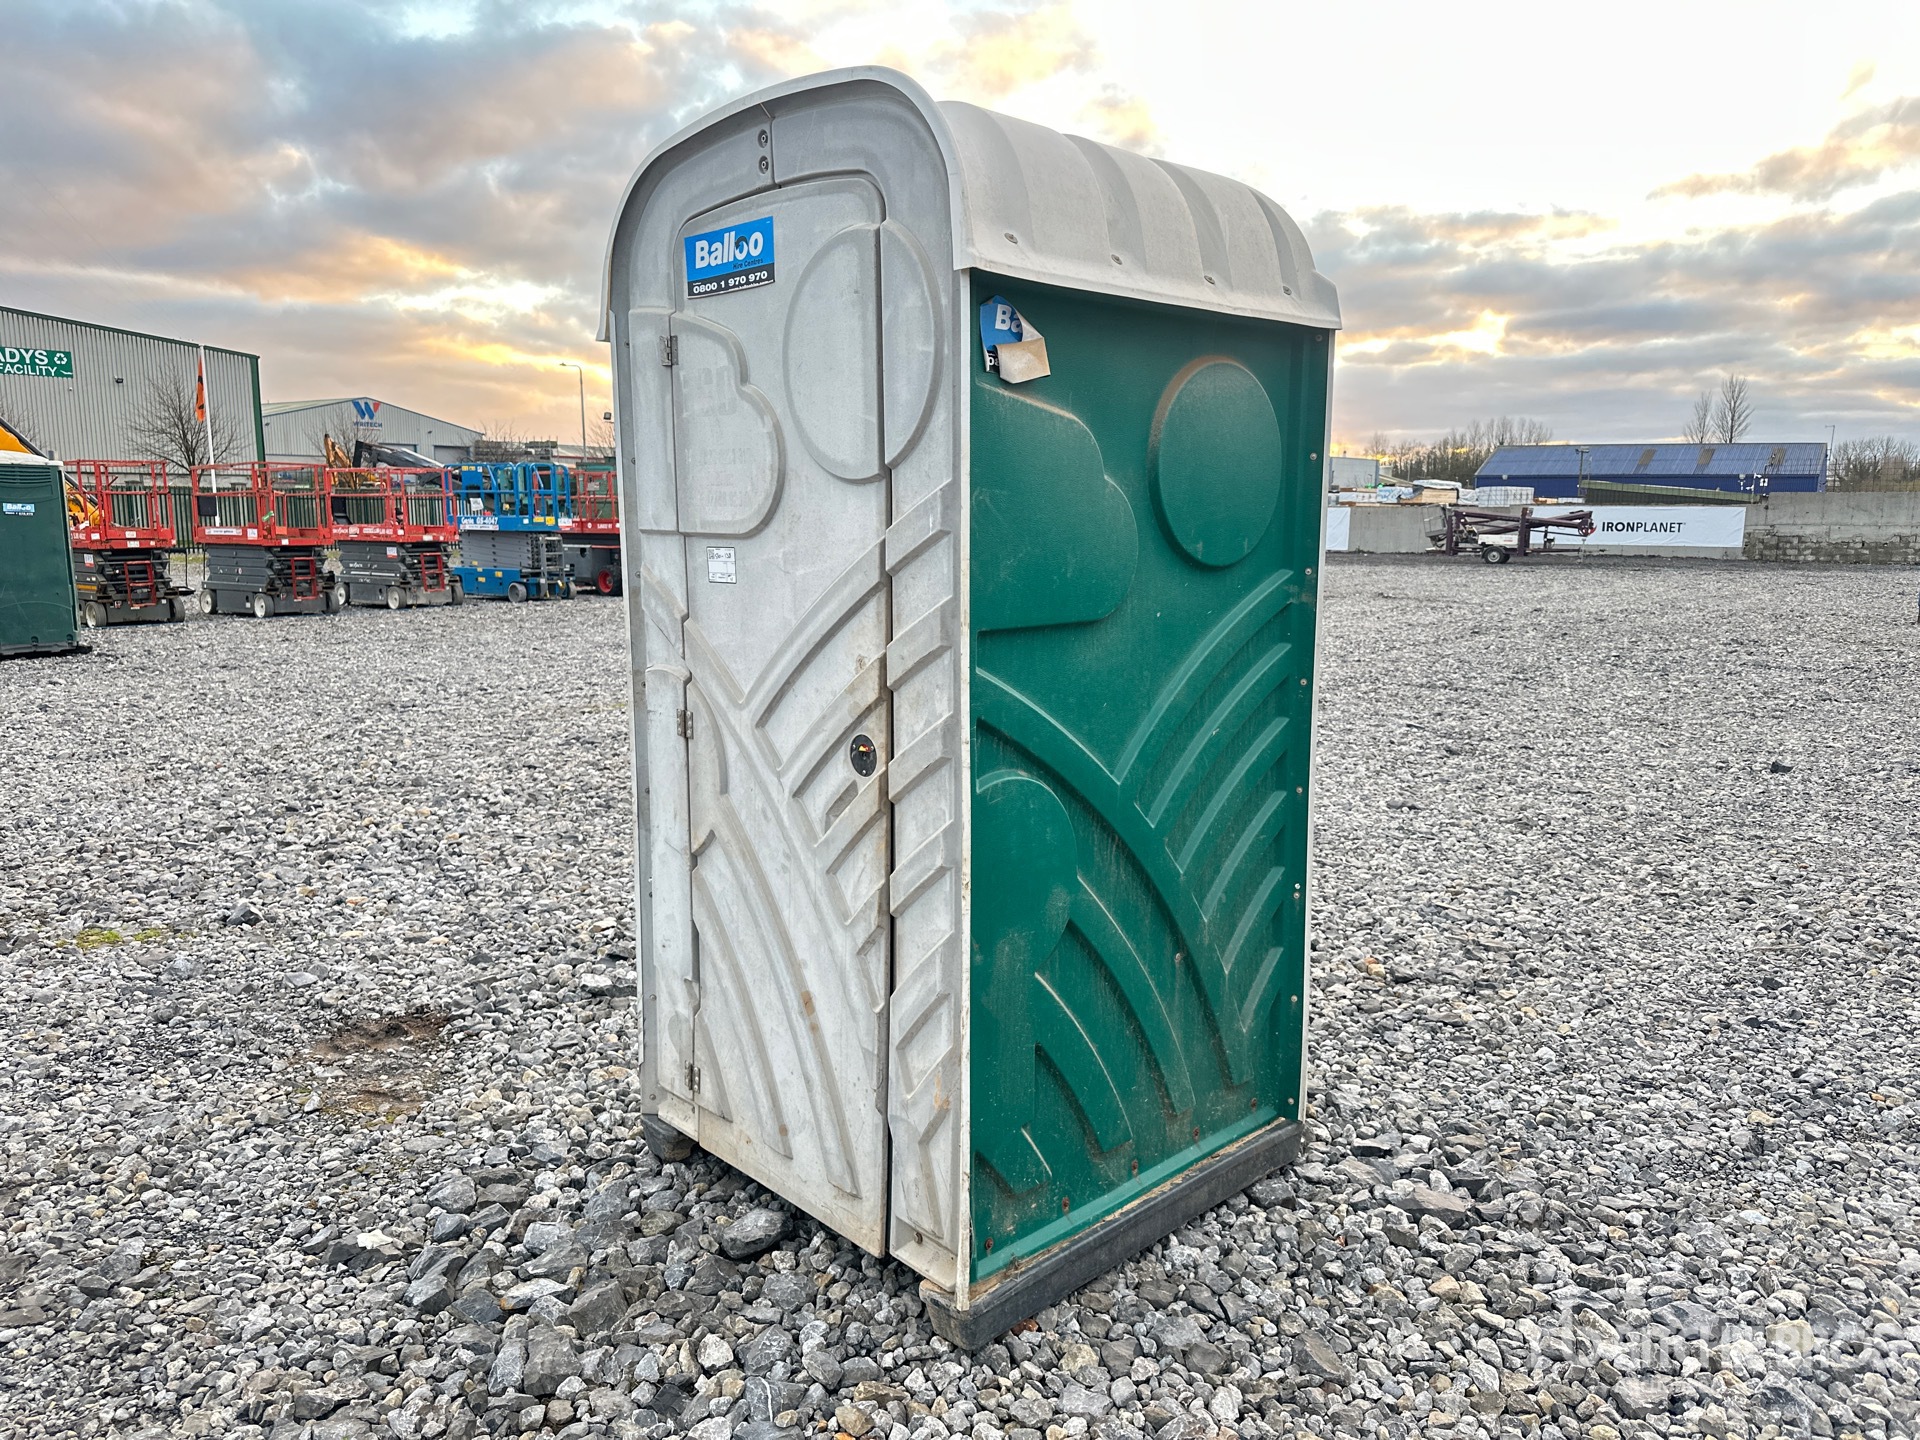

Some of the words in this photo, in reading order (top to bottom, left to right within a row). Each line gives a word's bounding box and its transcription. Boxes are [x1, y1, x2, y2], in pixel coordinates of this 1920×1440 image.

[695, 231, 764, 270] Balloo
[693, 282, 718, 294] 0800
[720, 281, 725, 289] 1
[727, 276, 747, 288] 970
[748, 270, 768, 282] 970
[353, 421, 383, 429] WRITECH
[1601, 521, 1683, 533] IRONPLANET
